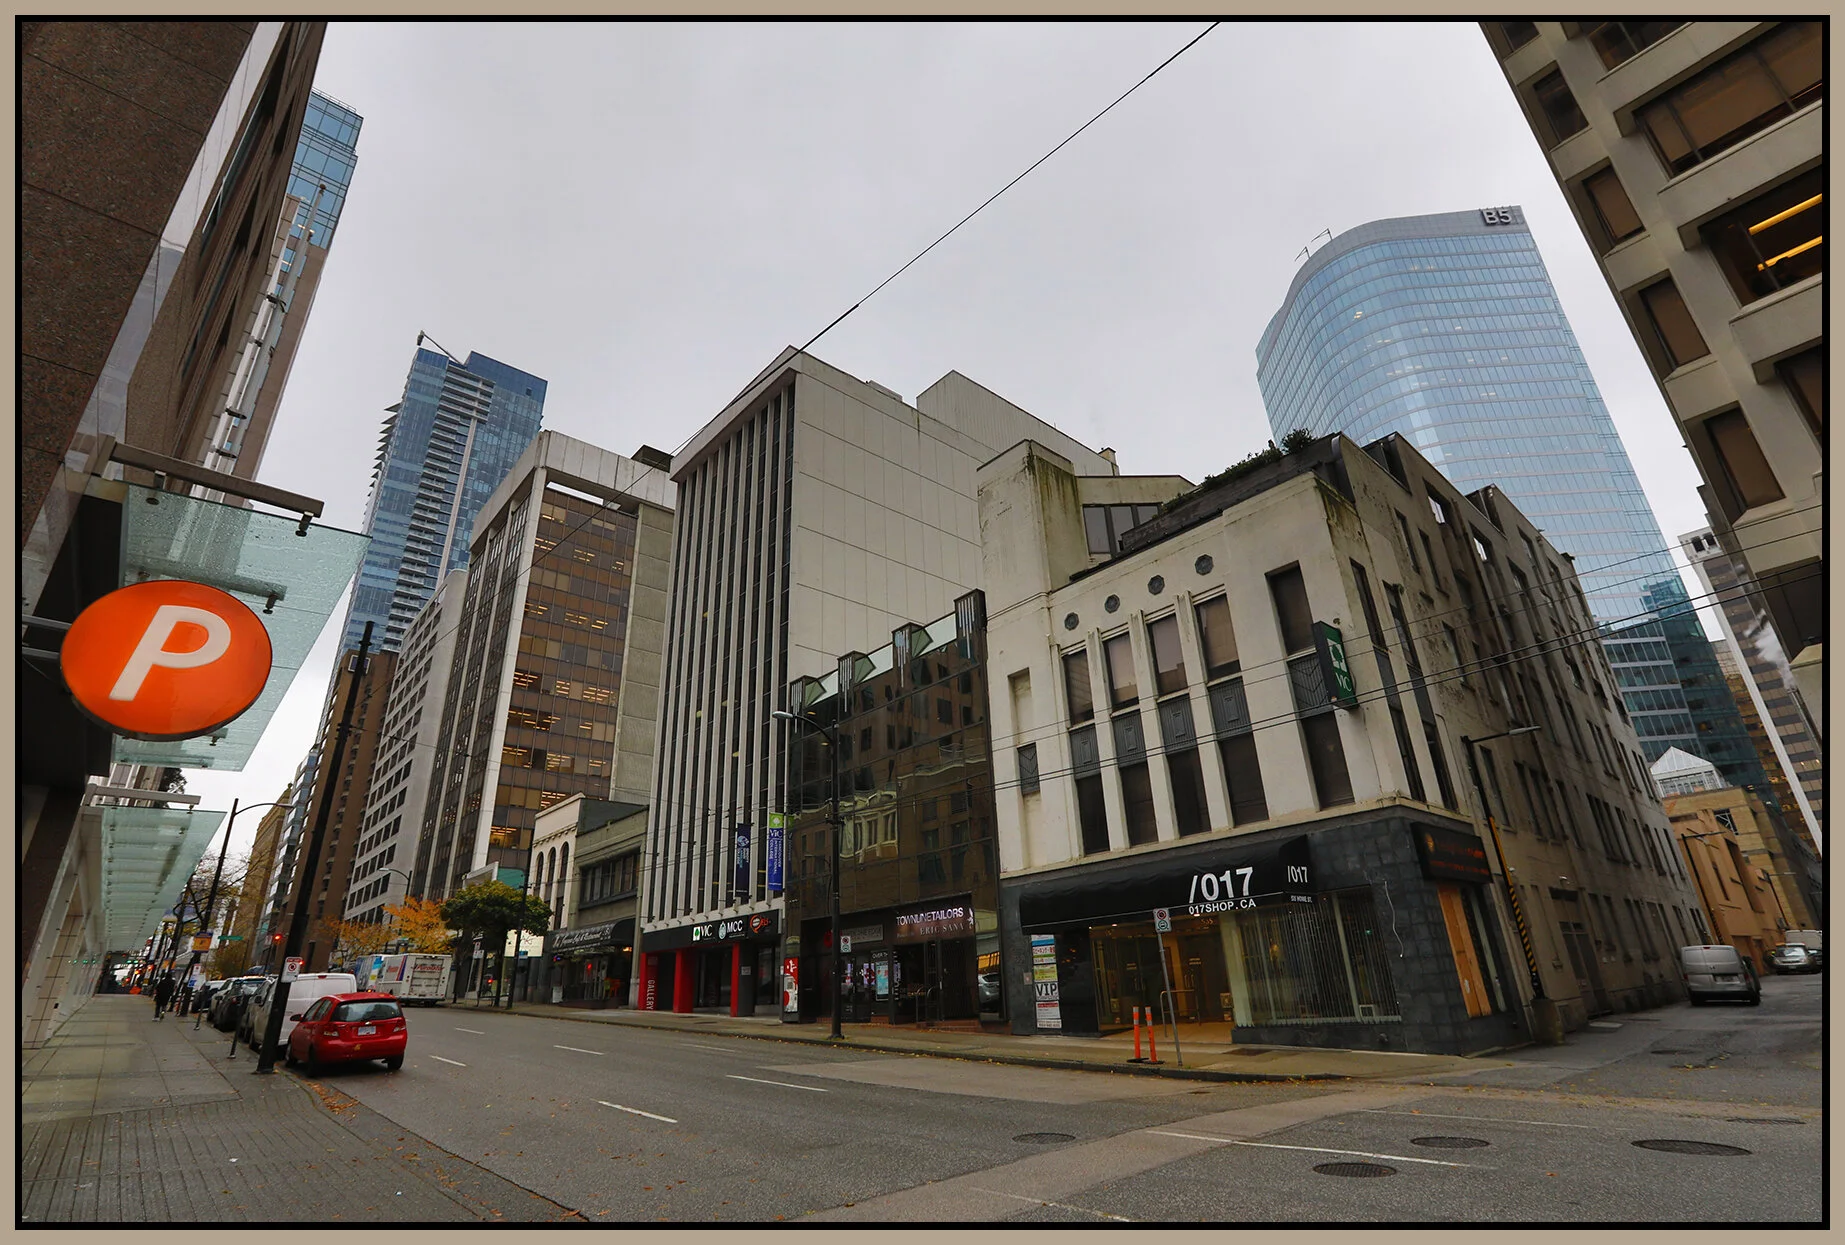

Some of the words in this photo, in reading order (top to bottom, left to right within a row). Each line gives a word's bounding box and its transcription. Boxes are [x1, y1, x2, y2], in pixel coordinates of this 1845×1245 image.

[1481, 207, 1513, 226] B5
[109, 604, 232, 702] P
[700, 924, 713, 937] VIC
[727, 919, 743, 933] MCC
[646, 979, 656, 1010] GALLERY
[1036, 983, 1057, 996] VIP
